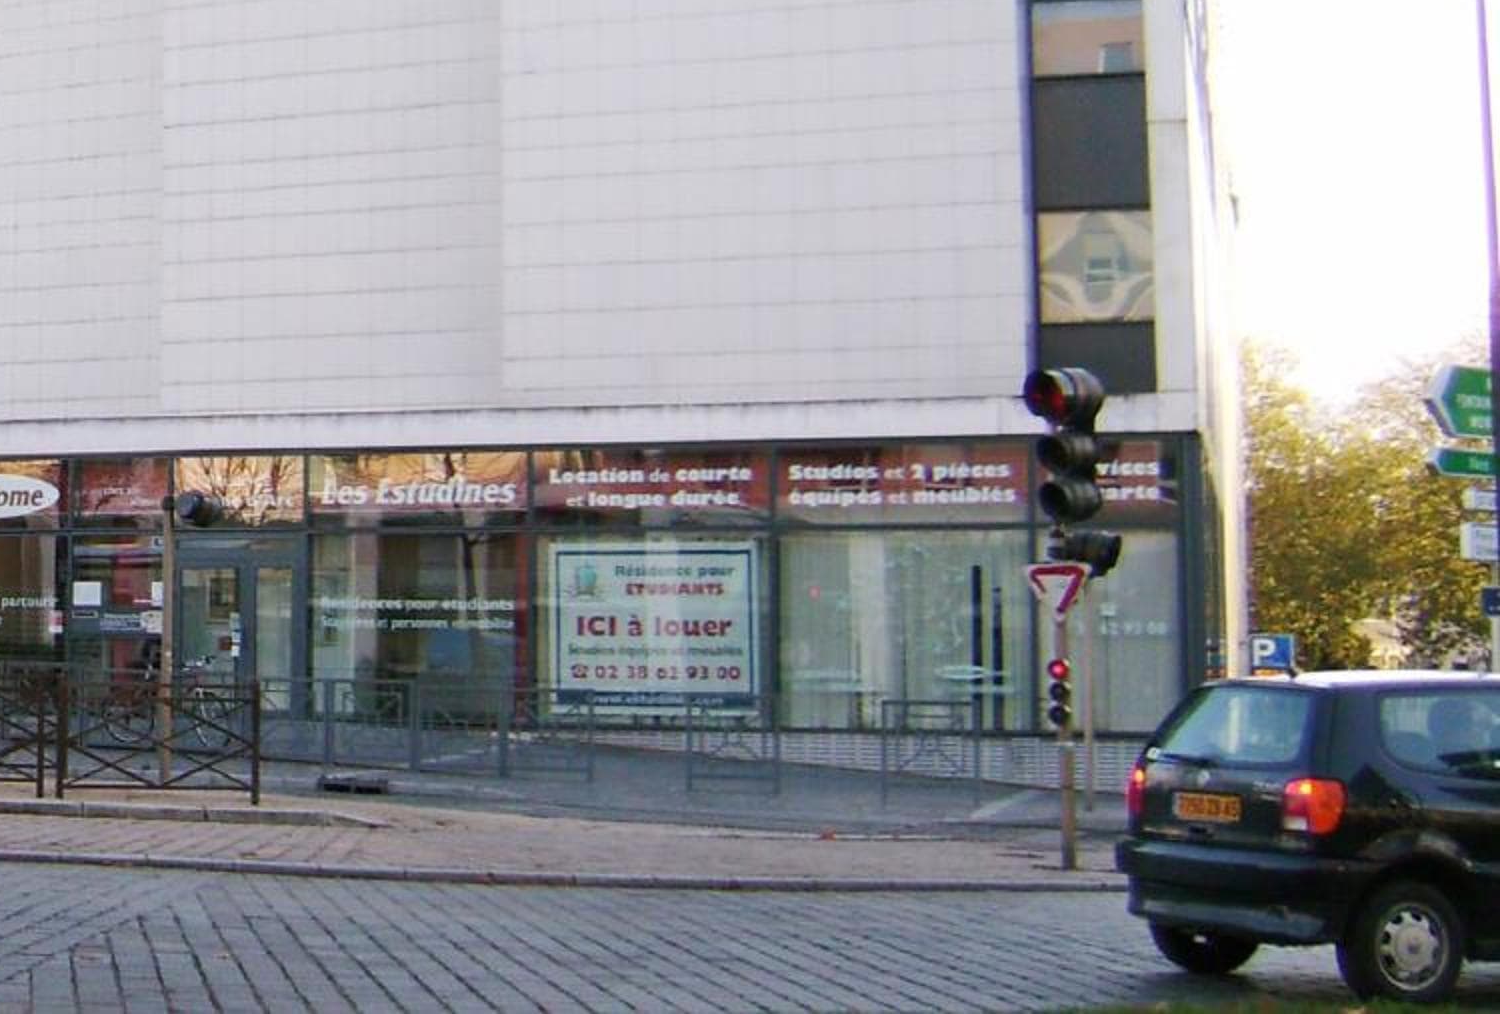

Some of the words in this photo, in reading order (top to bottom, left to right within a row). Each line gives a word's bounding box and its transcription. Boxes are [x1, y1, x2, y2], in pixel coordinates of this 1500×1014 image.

[549, 468, 645, 484] Location
[650, 468, 670, 483] de
[675, 467, 752, 482] courte
[788, 464, 880, 481] Studios
[883, 468, 905, 480] et
[910, 464, 926, 479] 2
[932, 461, 1011, 483] pièces
[1094, 459, 1158, 476] vices
[320, 478, 368, 505] Les
[375, 474, 518, 505] Estudines
[788, 487, 882, 507] équipés
[911, 487, 1015, 505] meublés
[1100, 485, 1158, 501] arte
[565, 495, 585, 507] et
[587, 492, 667, 509] longue
[670, 489, 741, 506] durée
[697, 566, 735, 578] pour
[625, 583, 724, 595] ETUDIANTS
[575, 615, 617, 637] ICI
[627, 613, 643, 637] à
[654, 615, 733, 637] louer
[1252, 638, 1276, 666] P
[594, 665, 618, 679] 02
[716, 665, 741, 679] 00
